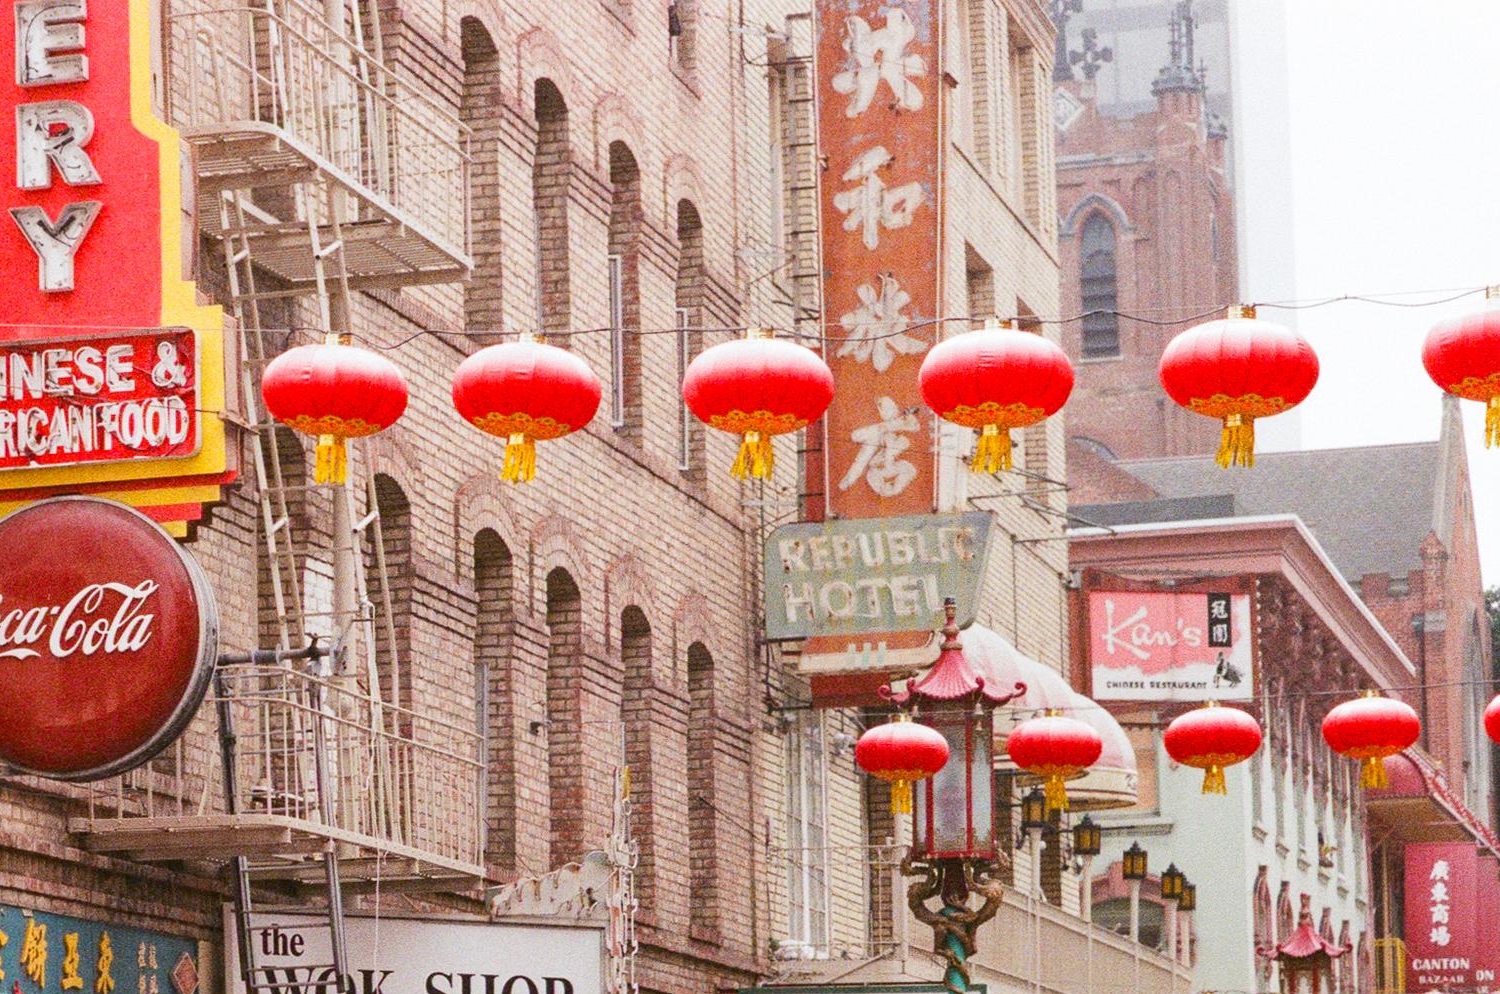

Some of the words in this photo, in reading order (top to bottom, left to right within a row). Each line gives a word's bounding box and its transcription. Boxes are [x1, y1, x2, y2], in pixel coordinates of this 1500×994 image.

[151, 340, 188, 388] &
[95, 395, 189, 452] FOOD
[779, 526, 978, 571] REPUBLIC
[784, 574, 943, 623] HOTEL
[1103, 599, 1202, 662] Kan's
[1150, 680, 1208, 689] RESTAURANT
[260, 923, 305, 957] the
[1412, 958, 1470, 970] CANTON
